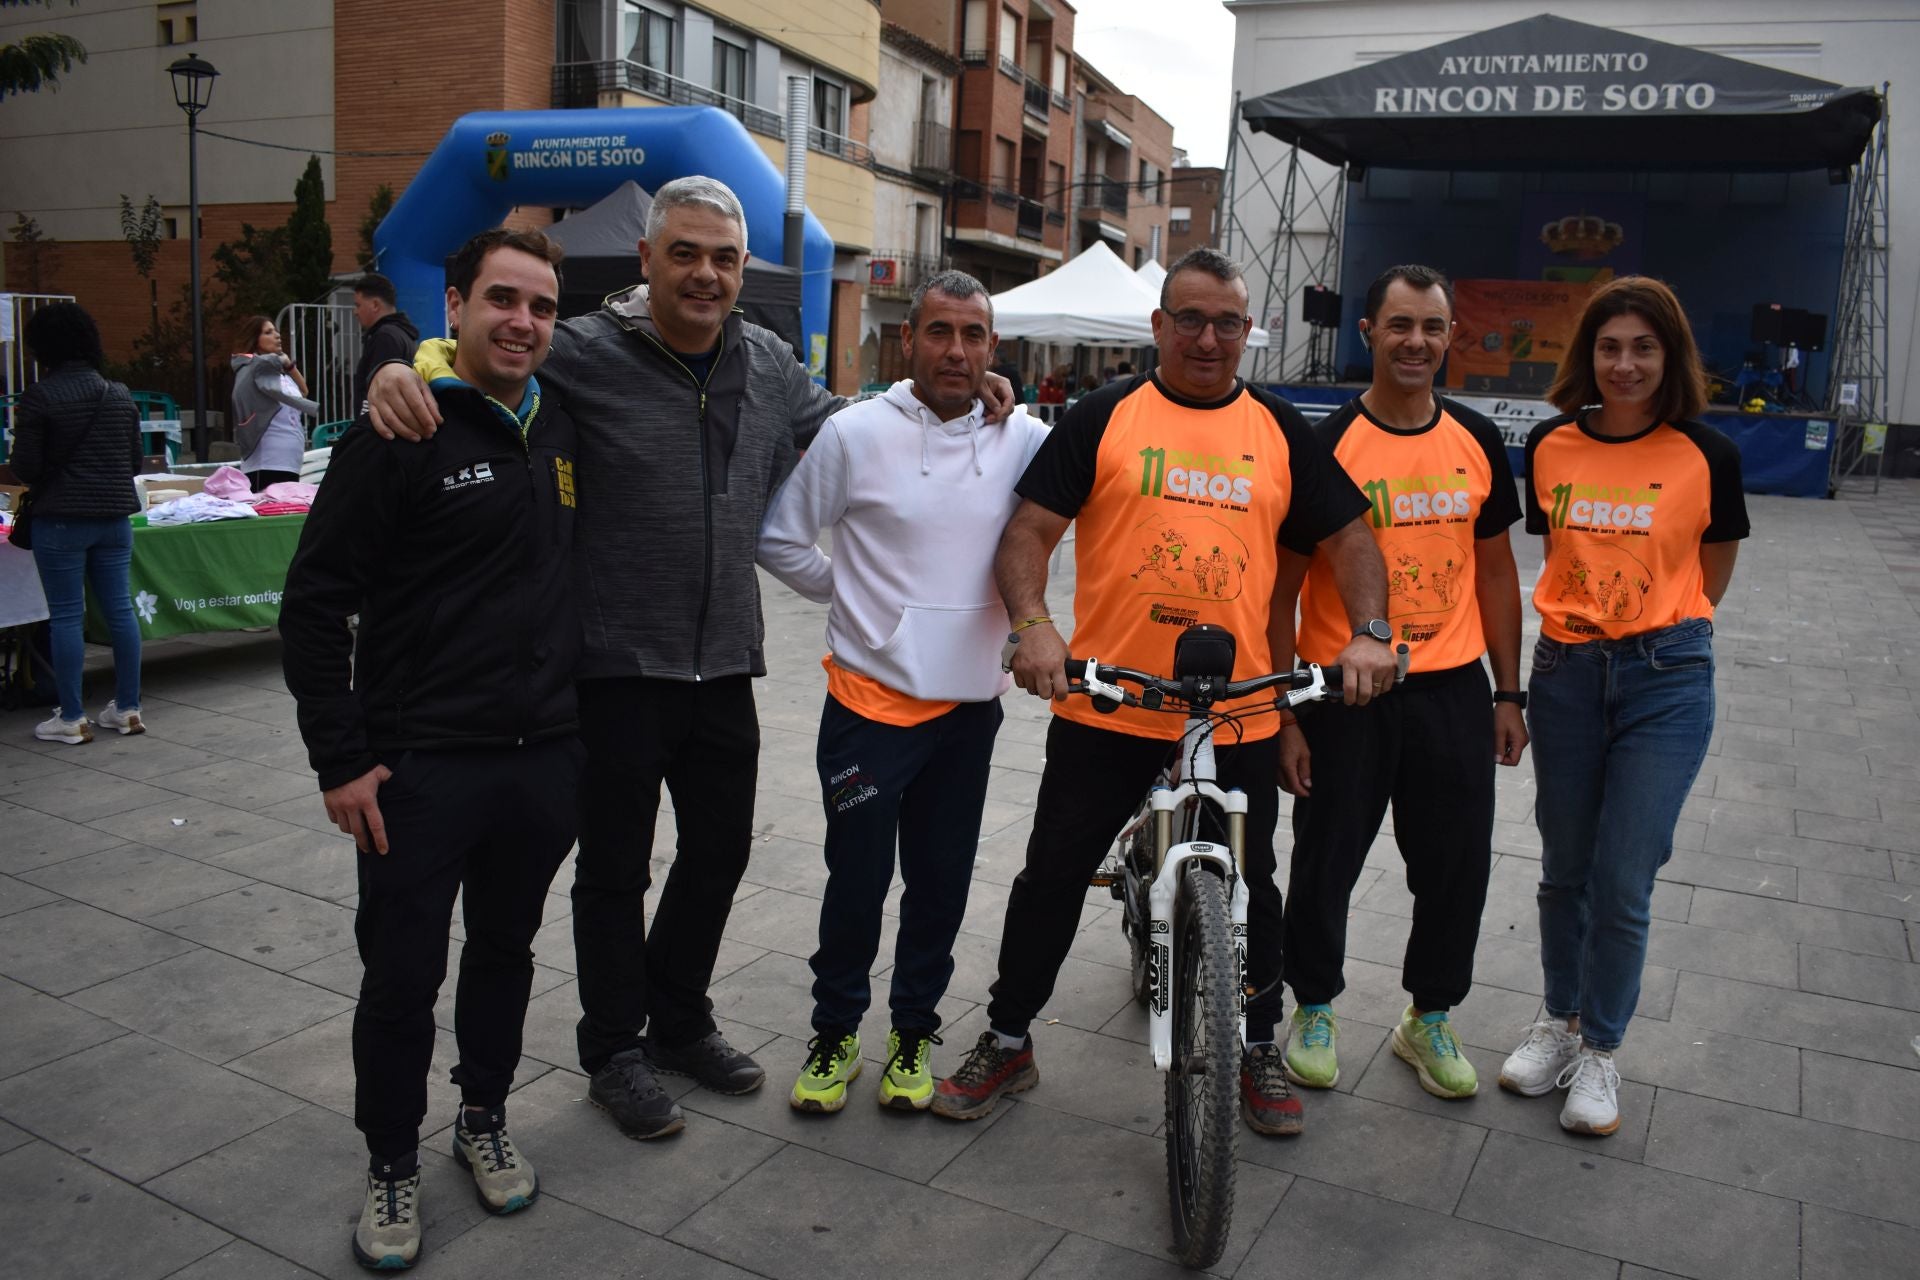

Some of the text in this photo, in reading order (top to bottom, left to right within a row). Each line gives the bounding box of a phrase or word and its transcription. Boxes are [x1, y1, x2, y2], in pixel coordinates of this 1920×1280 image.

[1438, 52, 1648, 75] AYUNTAMIENTO
[1374, 83, 1716, 112] RINCON DE SOTO
[532, 136, 626, 149] AYUNTAMIENTO DE
[513, 148, 645, 168] RINCÓN DE SOTO
[1139, 446, 1165, 497] 11
[1166, 467, 1253, 505] CROS
[1230, 504, 1249, 513] RIOJA
[1361, 478, 1392, 528] 11
[1394, 490, 1470, 519] CROS
[1551, 482, 1573, 529] 11
[1570, 499, 1655, 528] CROS
[174, 598, 196, 613] Voy
[199, 598, 206, 609] a
[208, 594, 241, 607] estar
[830, 764, 860, 785] RINCON
[837, 788, 878, 813] ATLETISMO
[491, 1114, 498, 1122] S
